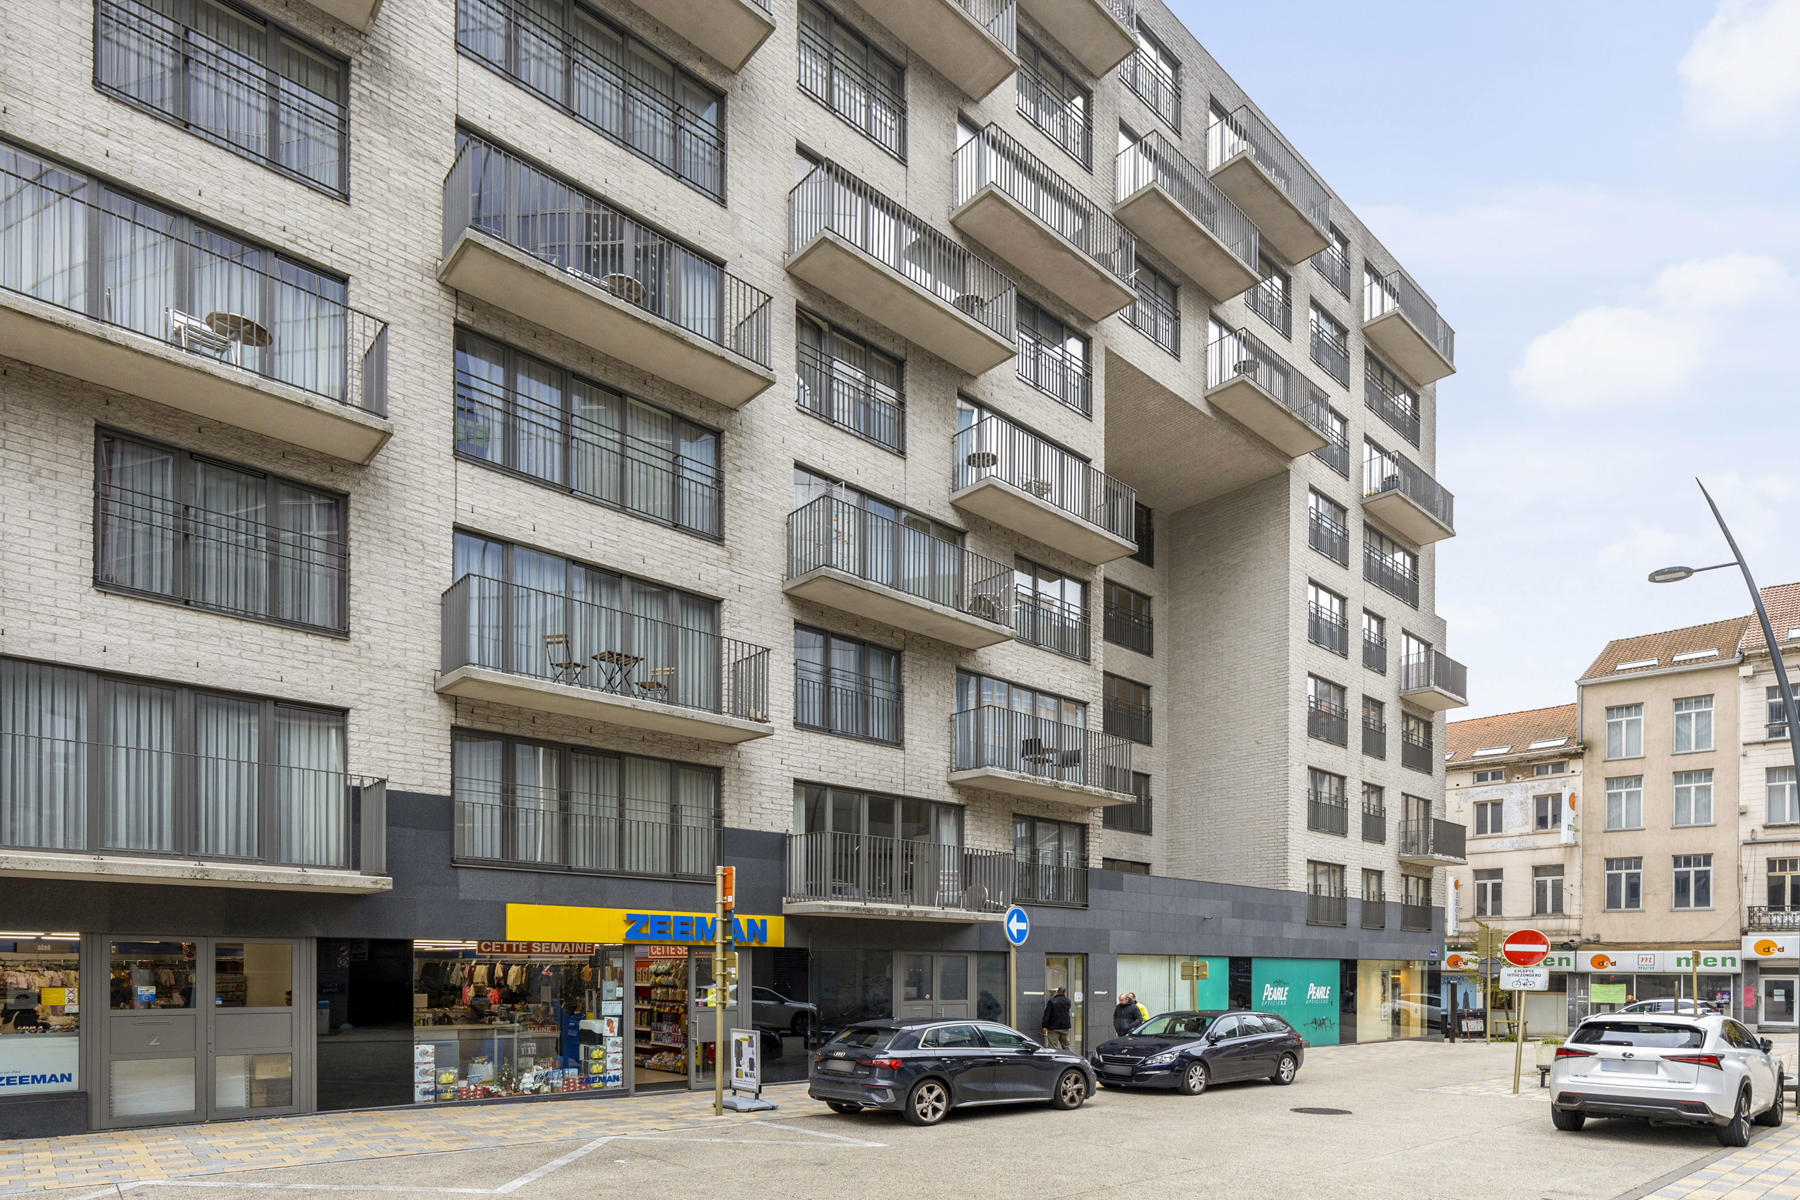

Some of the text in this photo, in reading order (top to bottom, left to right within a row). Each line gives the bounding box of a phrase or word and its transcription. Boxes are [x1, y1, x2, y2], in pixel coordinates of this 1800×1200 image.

[625, 913, 767, 943] ZEEMAN
[480, 941, 592, 953] CETTE SEMAINE
[1536, 956, 1571, 967] en
[1677, 955, 1736, 967] men
[1262, 984, 1289, 1000] PEARLE
[1307, 983, 1331, 999] PEARLE
[579, 1075, 620, 1085] ZEEMAN
